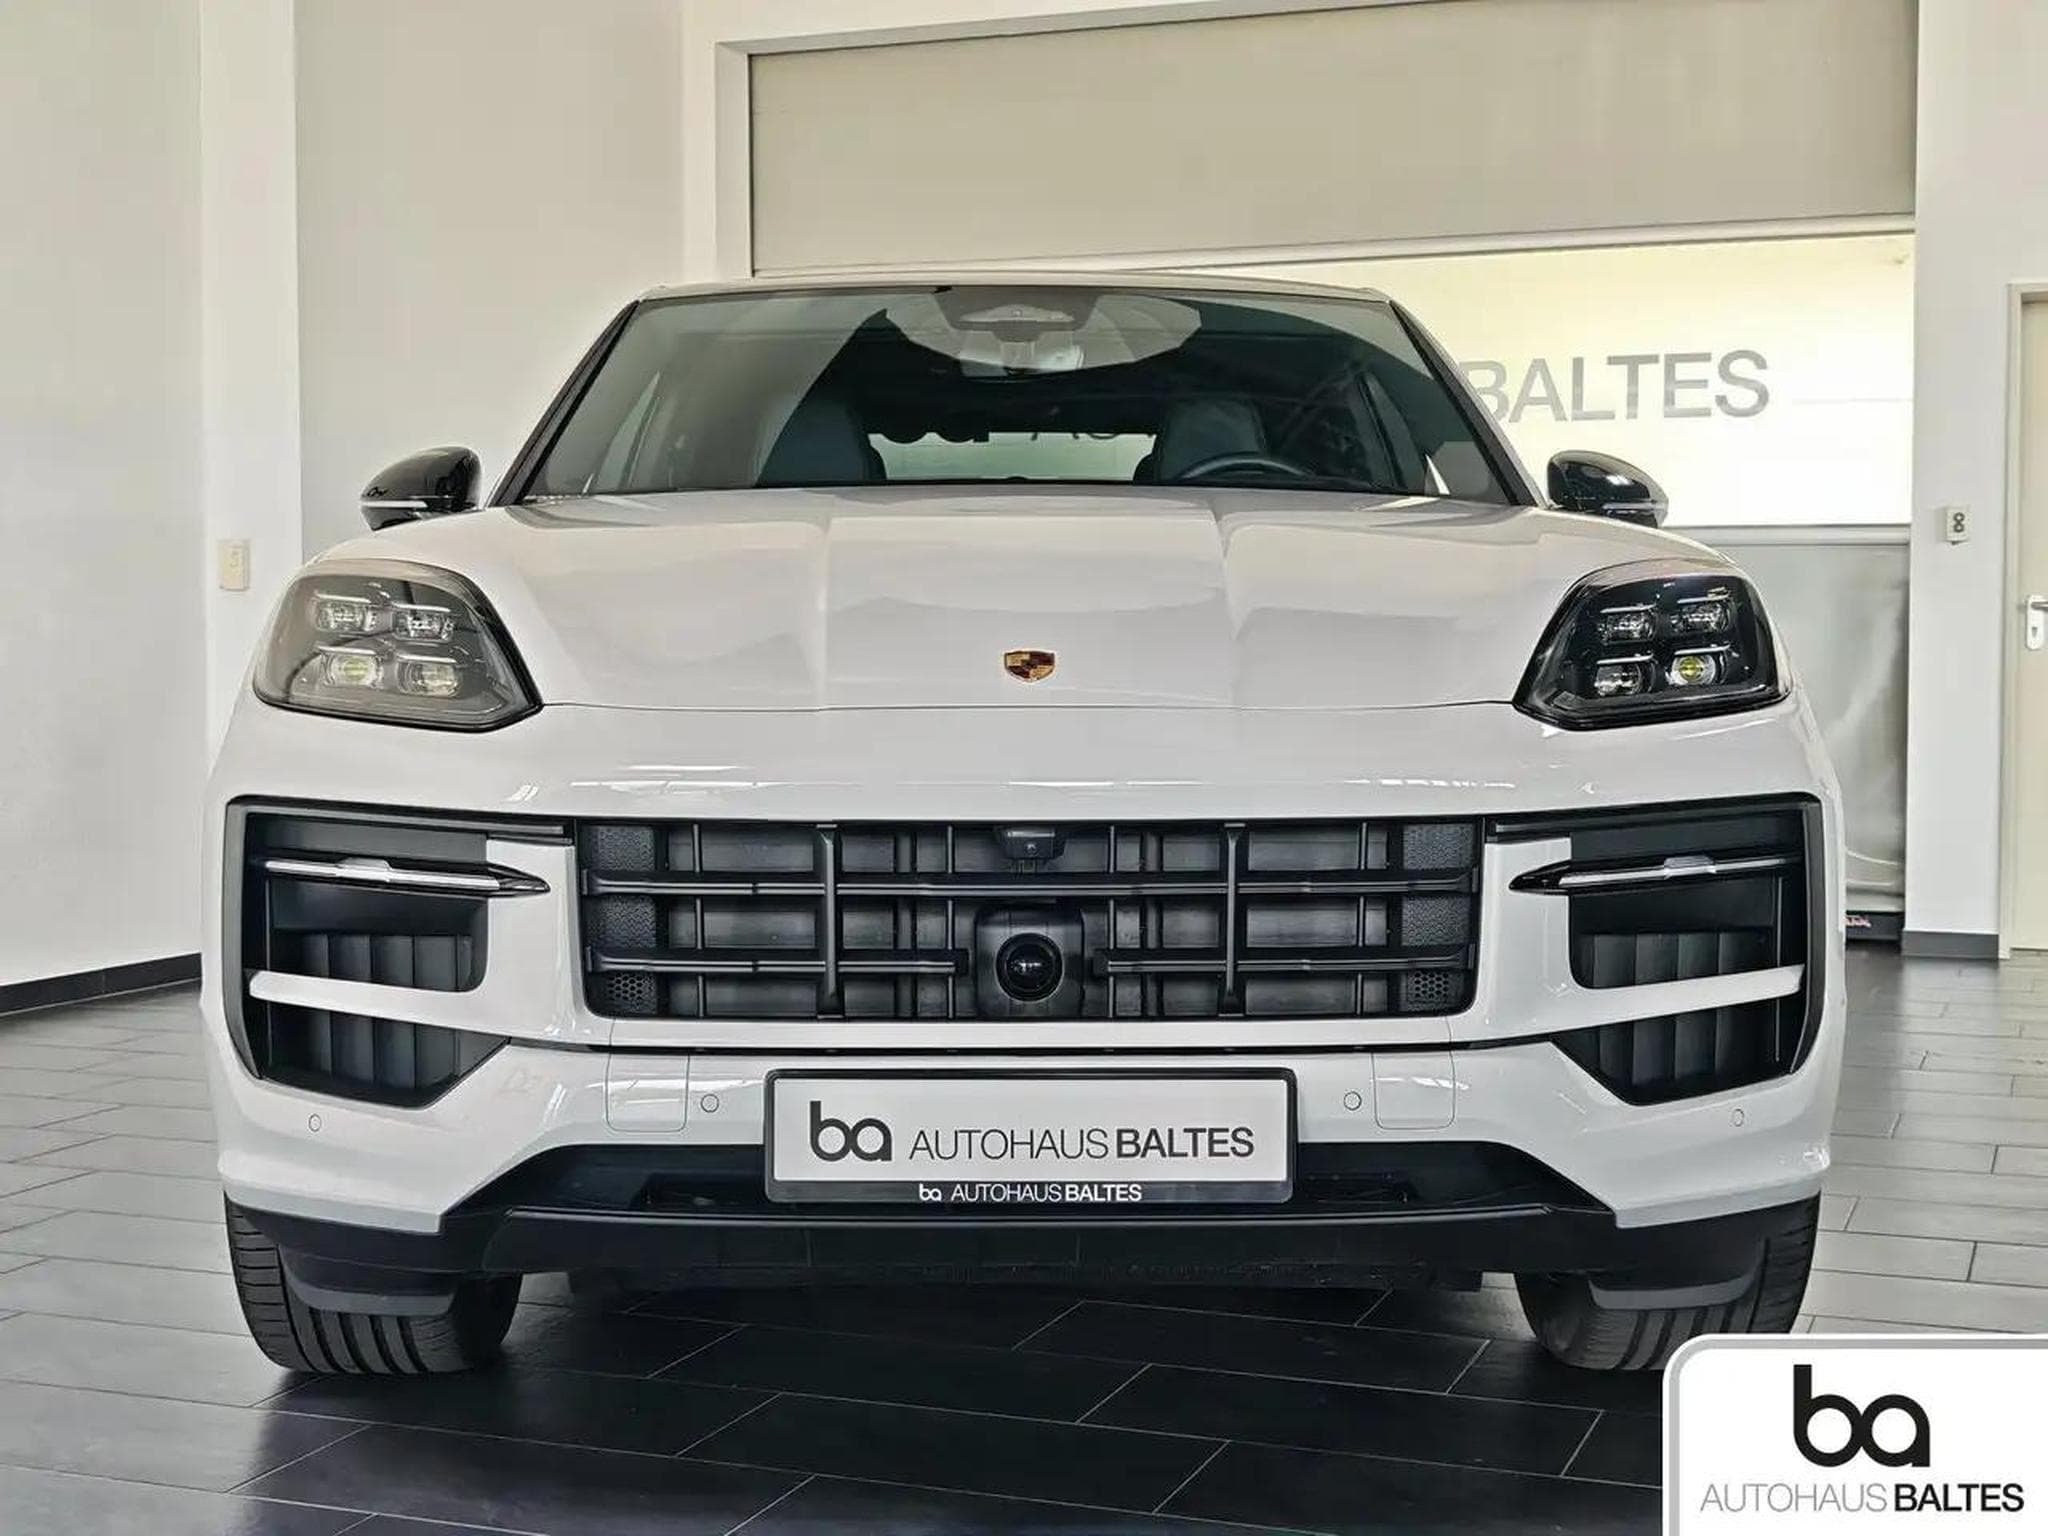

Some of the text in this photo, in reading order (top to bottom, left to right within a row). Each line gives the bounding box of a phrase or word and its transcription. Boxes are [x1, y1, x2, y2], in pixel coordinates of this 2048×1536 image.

[810, 1100, 1255, 1162] ba AUTOHAUS BALTES
[919, 1184, 1142, 1201] ba AUTOHAUS BALTES
